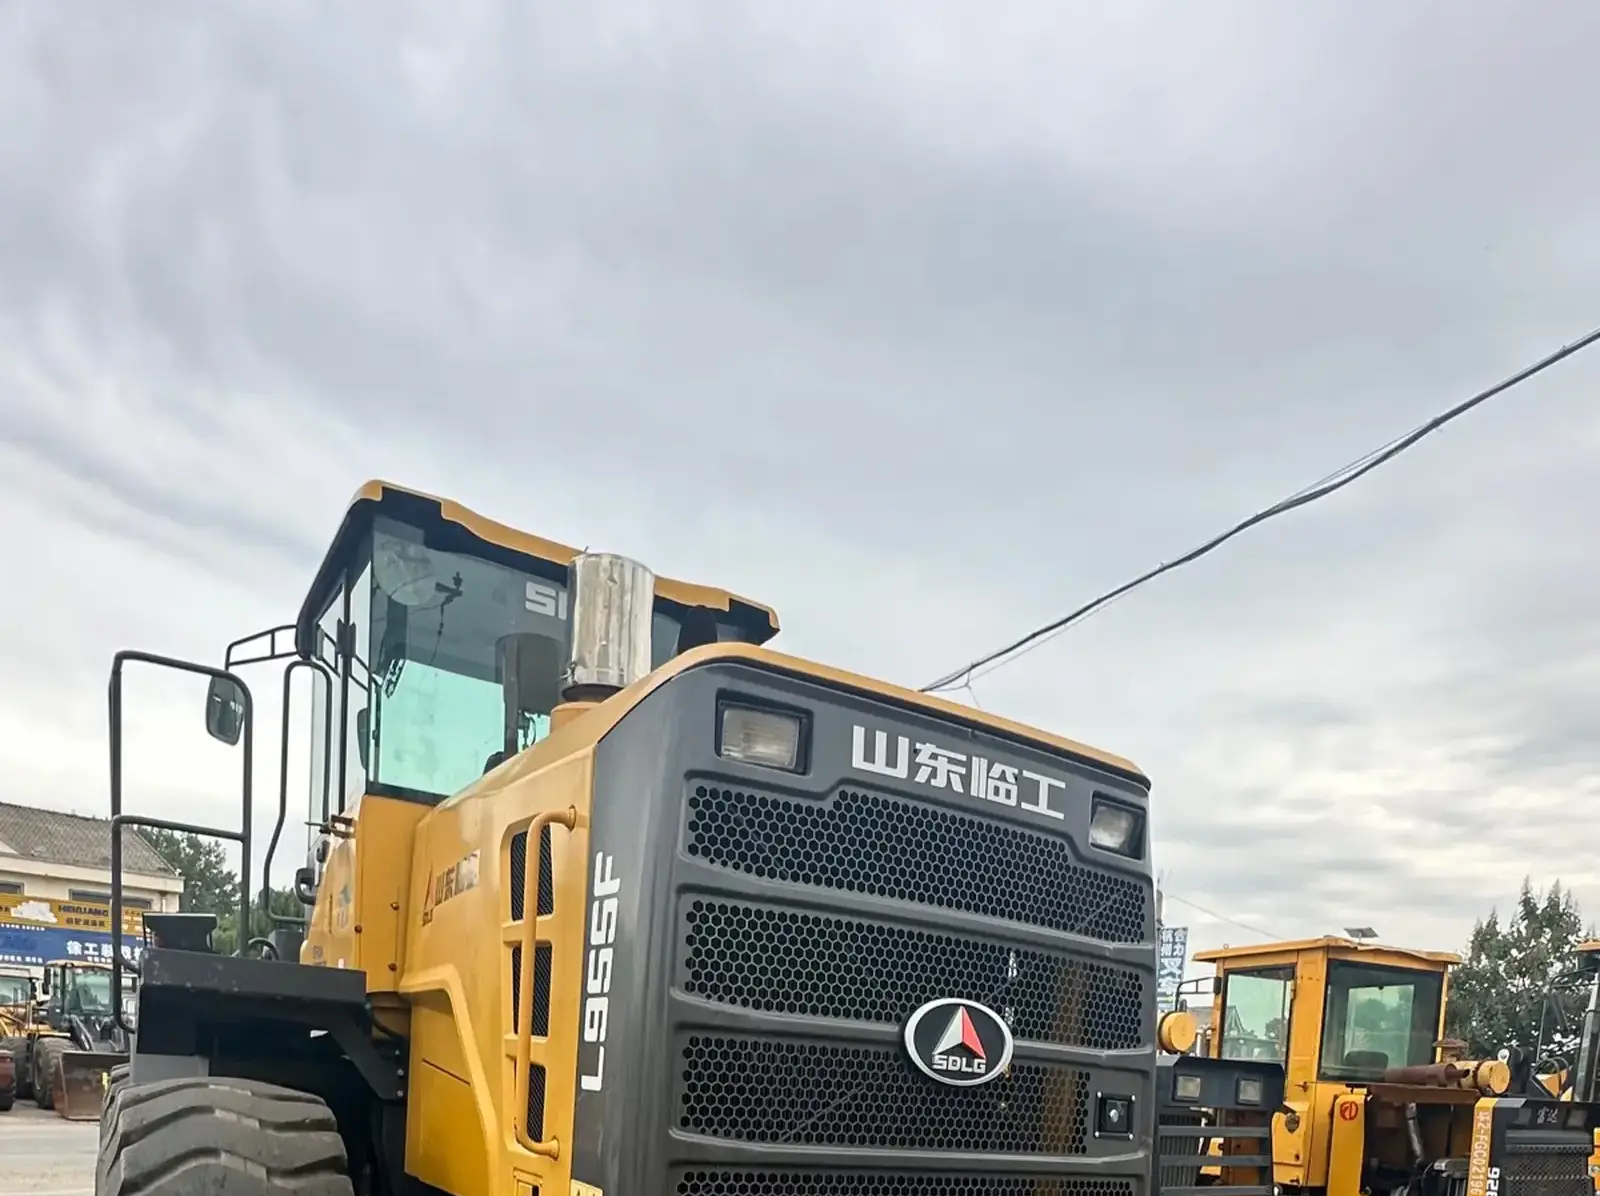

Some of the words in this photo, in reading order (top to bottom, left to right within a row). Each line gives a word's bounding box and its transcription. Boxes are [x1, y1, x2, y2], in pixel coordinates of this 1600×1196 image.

[852, 725, 1066, 820] 山东临工
[581, 851, 621, 1091] L955F
[931, 1054, 987, 1074] SDLG
